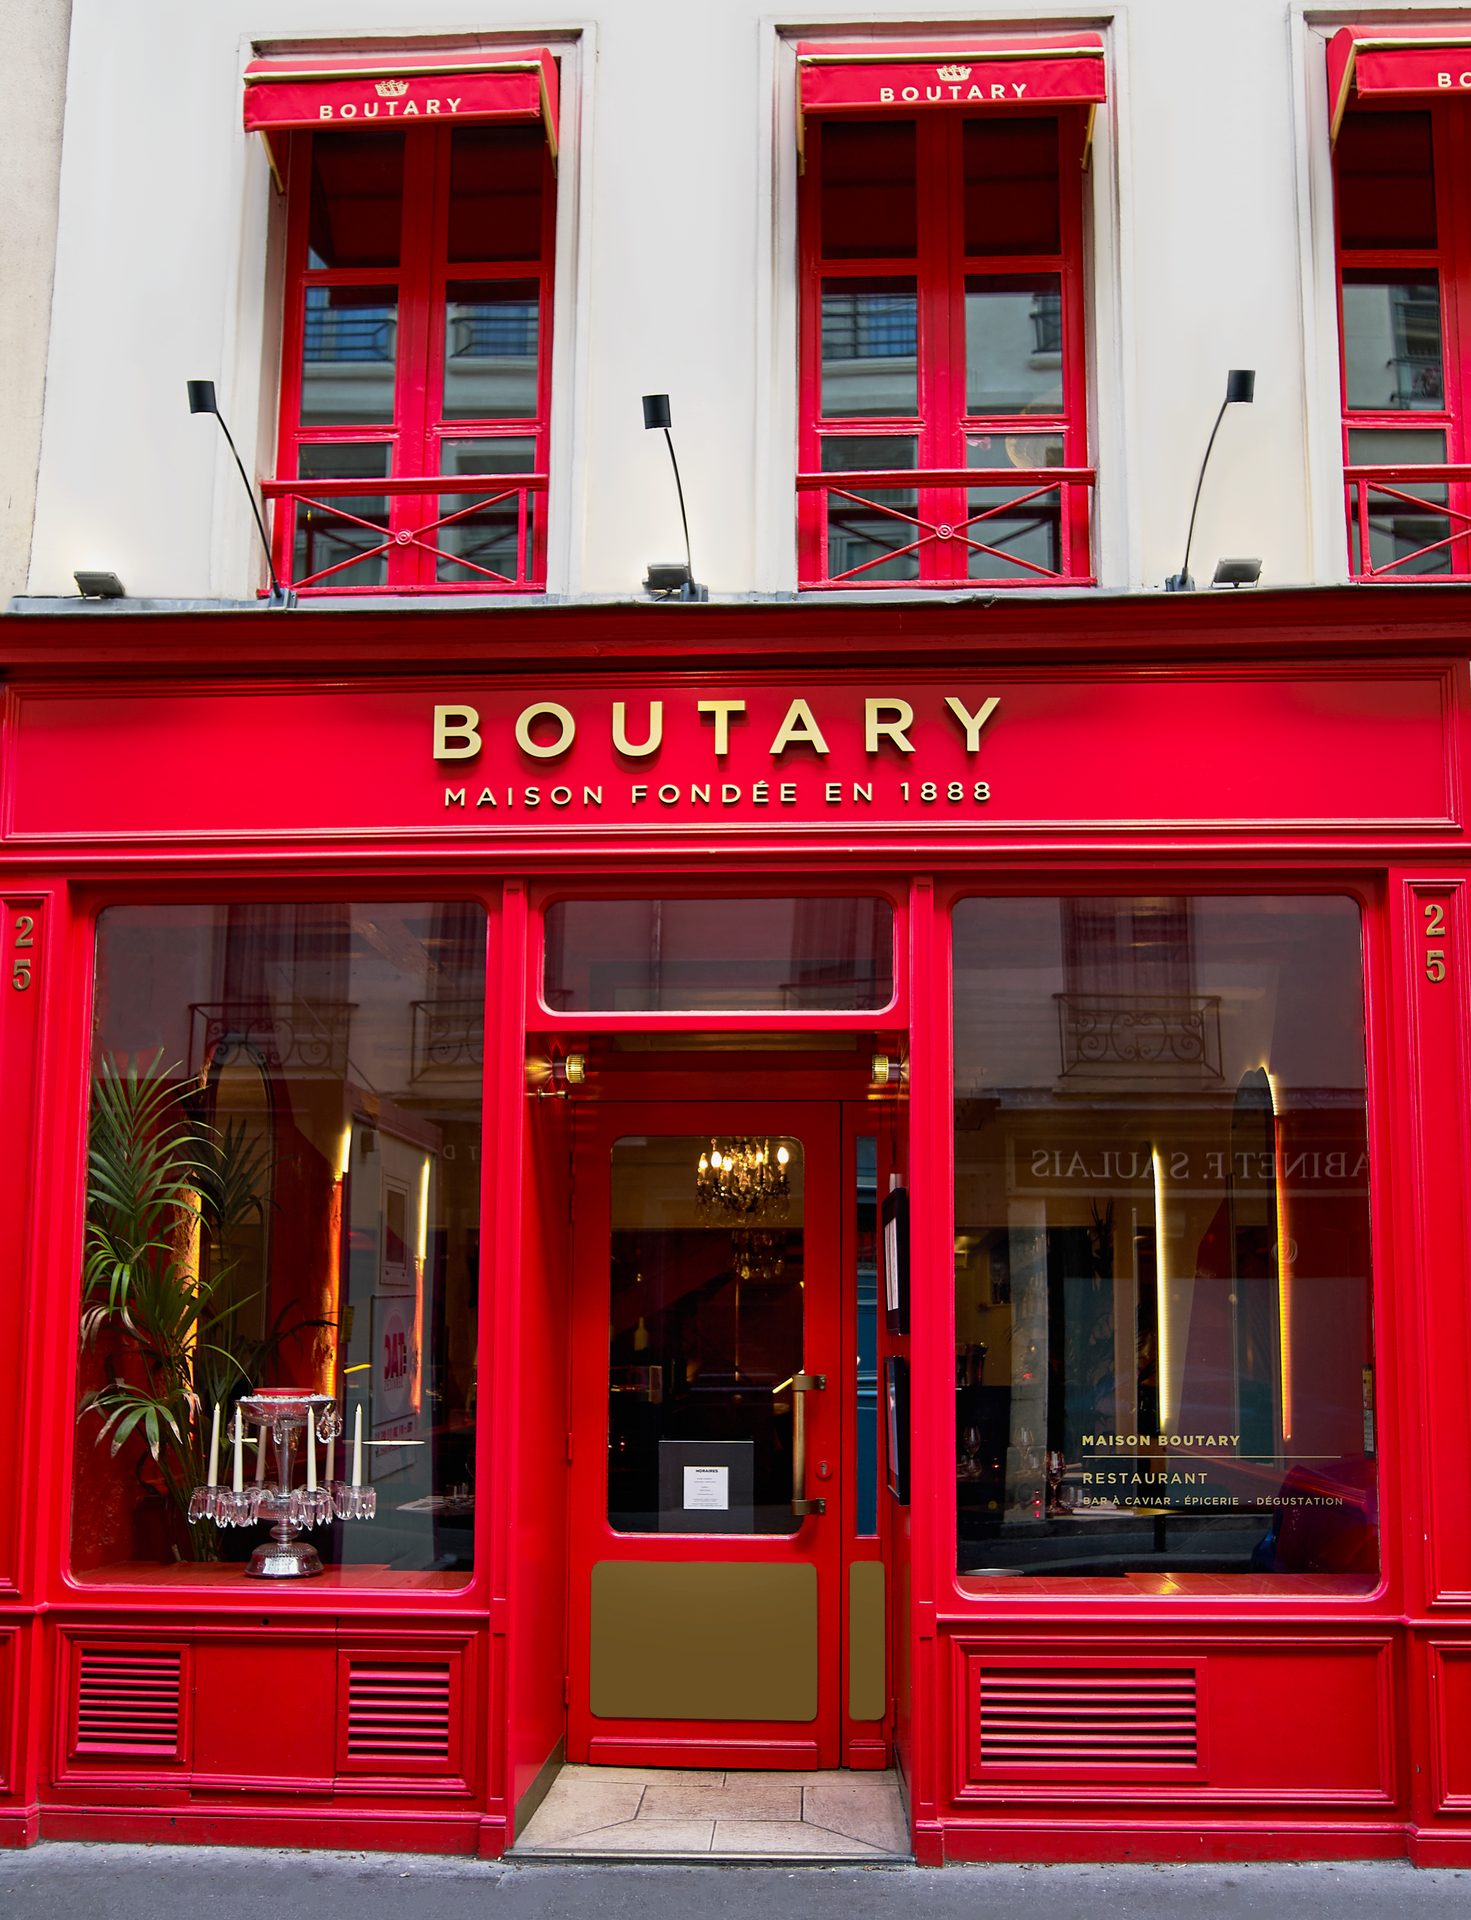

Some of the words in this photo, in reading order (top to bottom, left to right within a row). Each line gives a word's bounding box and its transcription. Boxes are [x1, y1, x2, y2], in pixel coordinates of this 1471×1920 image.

[880, 83, 1027, 102] BOUTARY
[319, 97, 461, 119] BOUTARY
[433, 696, 1001, 760] BOUTARY
[444, 785, 603, 806] MAISON
[631, 780, 797, 804] FONDÉE
[825, 782, 873, 802] EN
[900, 781, 991, 801] 1888
[1082, 1435, 1150, 1446] MAISON
[1158, 1435, 1240, 1446] BOUTARY
[1082, 1472, 1208, 1485] RESTAURANT
[1083, 1496, 1108, 1505] BAR
[1112, 1494, 1121, 1505] À
[1124, 1496, 1171, 1505] CAVIAR
[1184, 1495, 1239, 1506] ÉPICERIE
[1256, 1495, 1343, 1506] DÉGUSTATION
